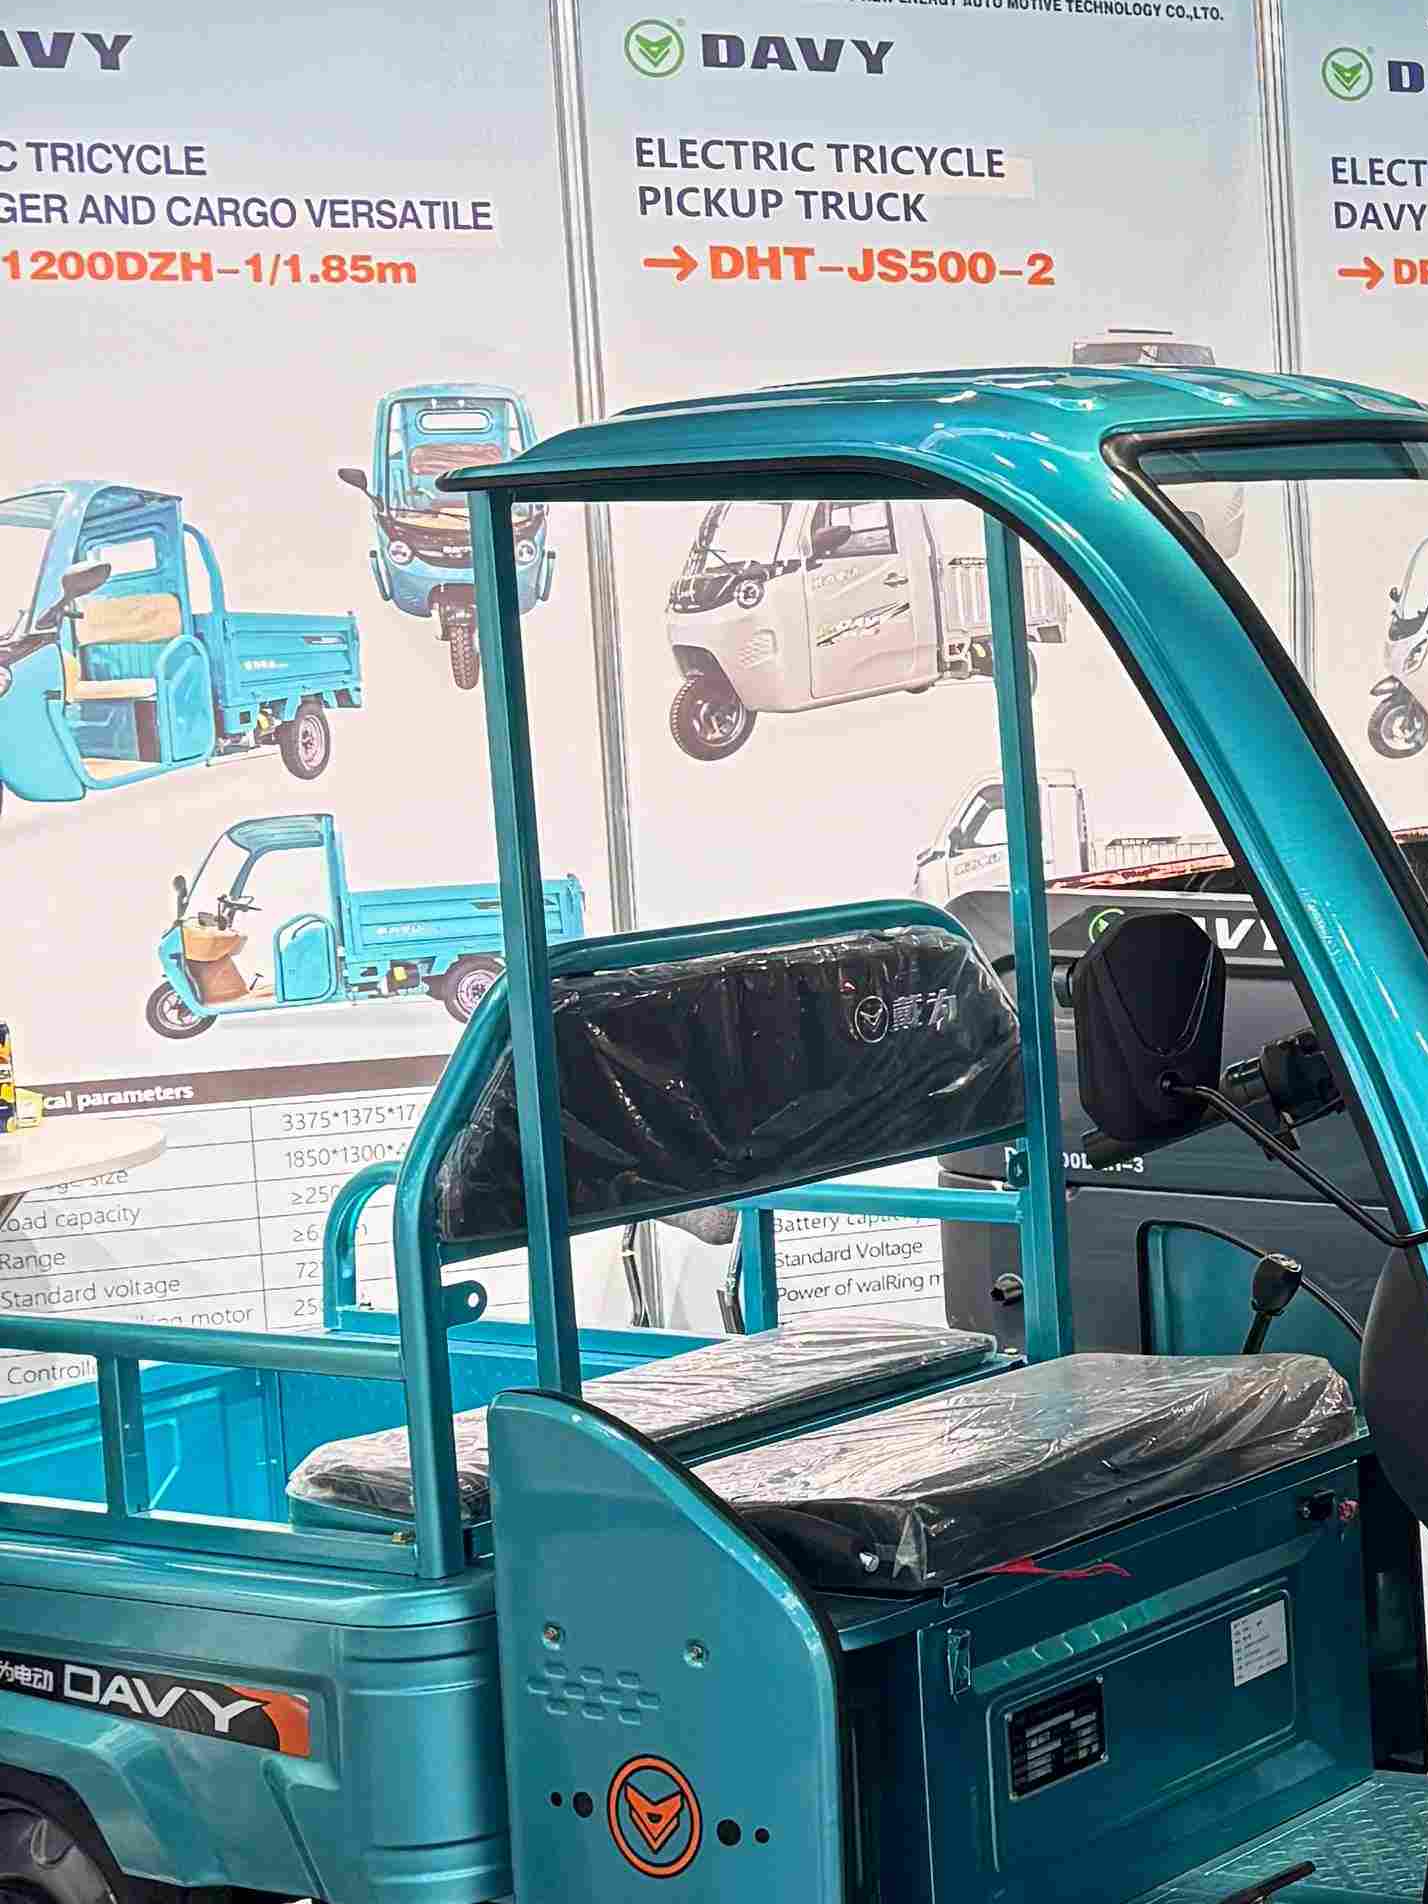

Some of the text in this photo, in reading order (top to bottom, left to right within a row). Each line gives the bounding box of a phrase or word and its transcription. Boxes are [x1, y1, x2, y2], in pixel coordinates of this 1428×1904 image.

[701, 33, 894, 74] DAVY
[26, 141, 208, 177] TRICYCLE
[635, 137, 1006, 179] ELECTRIC TRICYCLE
[79, 194, 156, 226] AND
[166, 196, 297, 229] CARGO
[304, 198, 494, 231] VERSATILE
[637, 185, 928, 223] PICKUP TRUCK
[1333, 201, 1427, 234] DAVY
[709, 245, 1055, 286] DHT-JS500-2
[43, 1086, 194, 1112] cal parameters
[281, 1104, 415, 1132] 3375137517
[55, 1205, 141, 1230] capacity
[0, 1251, 66, 1272] Range
[295, 1261, 320, 1279] 72
[776, 1241, 923, 1269] Standard Voltage
[0, 1278, 181, 1309] Standard voltage
[834, 1279, 853, 1296] of
[293, 1297, 318, 1317] 25
[63, 1663, 270, 1733] DAVY
